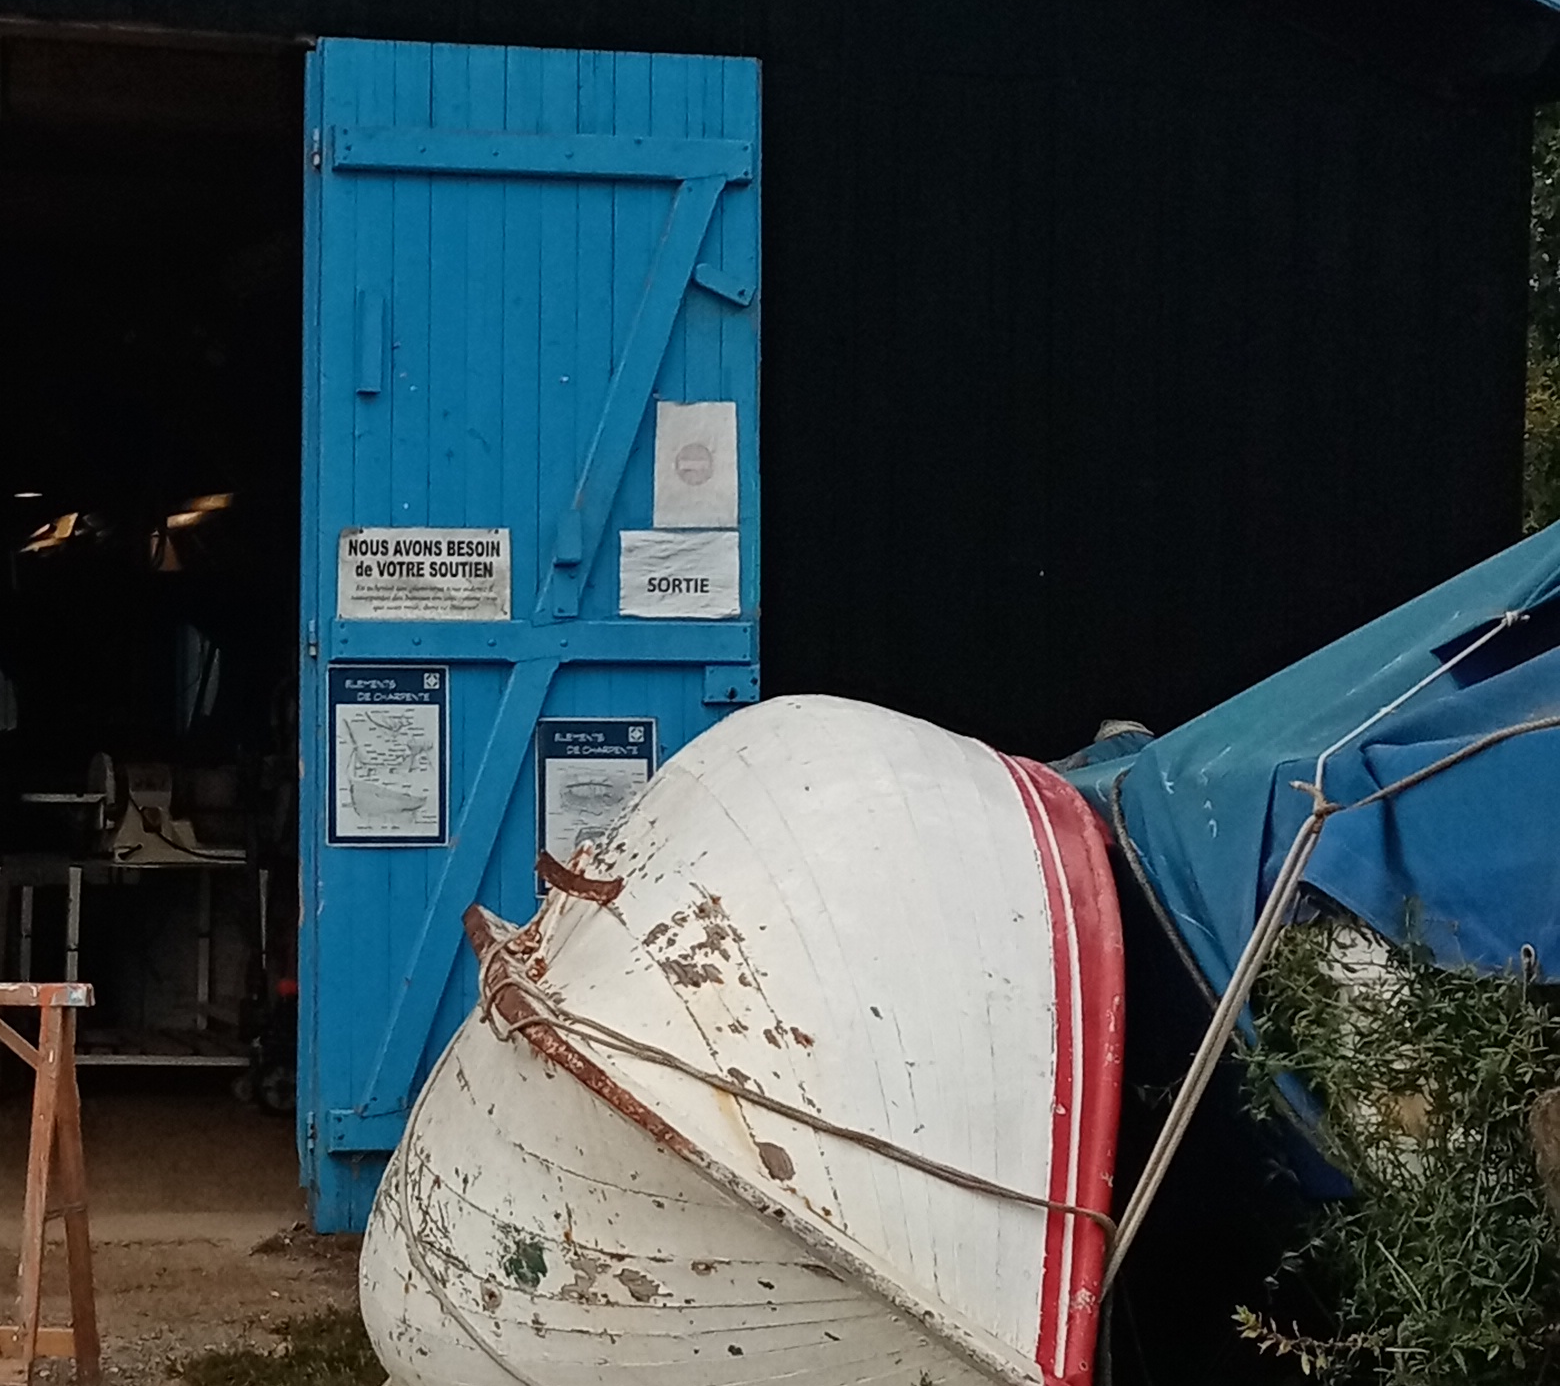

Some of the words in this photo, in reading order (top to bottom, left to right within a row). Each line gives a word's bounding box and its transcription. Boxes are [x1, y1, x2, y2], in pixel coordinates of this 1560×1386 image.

[348, 539, 389, 557] NOUS
[393, 539, 443, 557] AVONS
[447, 540, 501, 558] BESOIN
[355, 560, 373, 578] de
[376, 561, 425, 578] VOTRE
[429, 561, 494, 578] SOUTIEN
[647, 576, 710, 595] SORTIE
